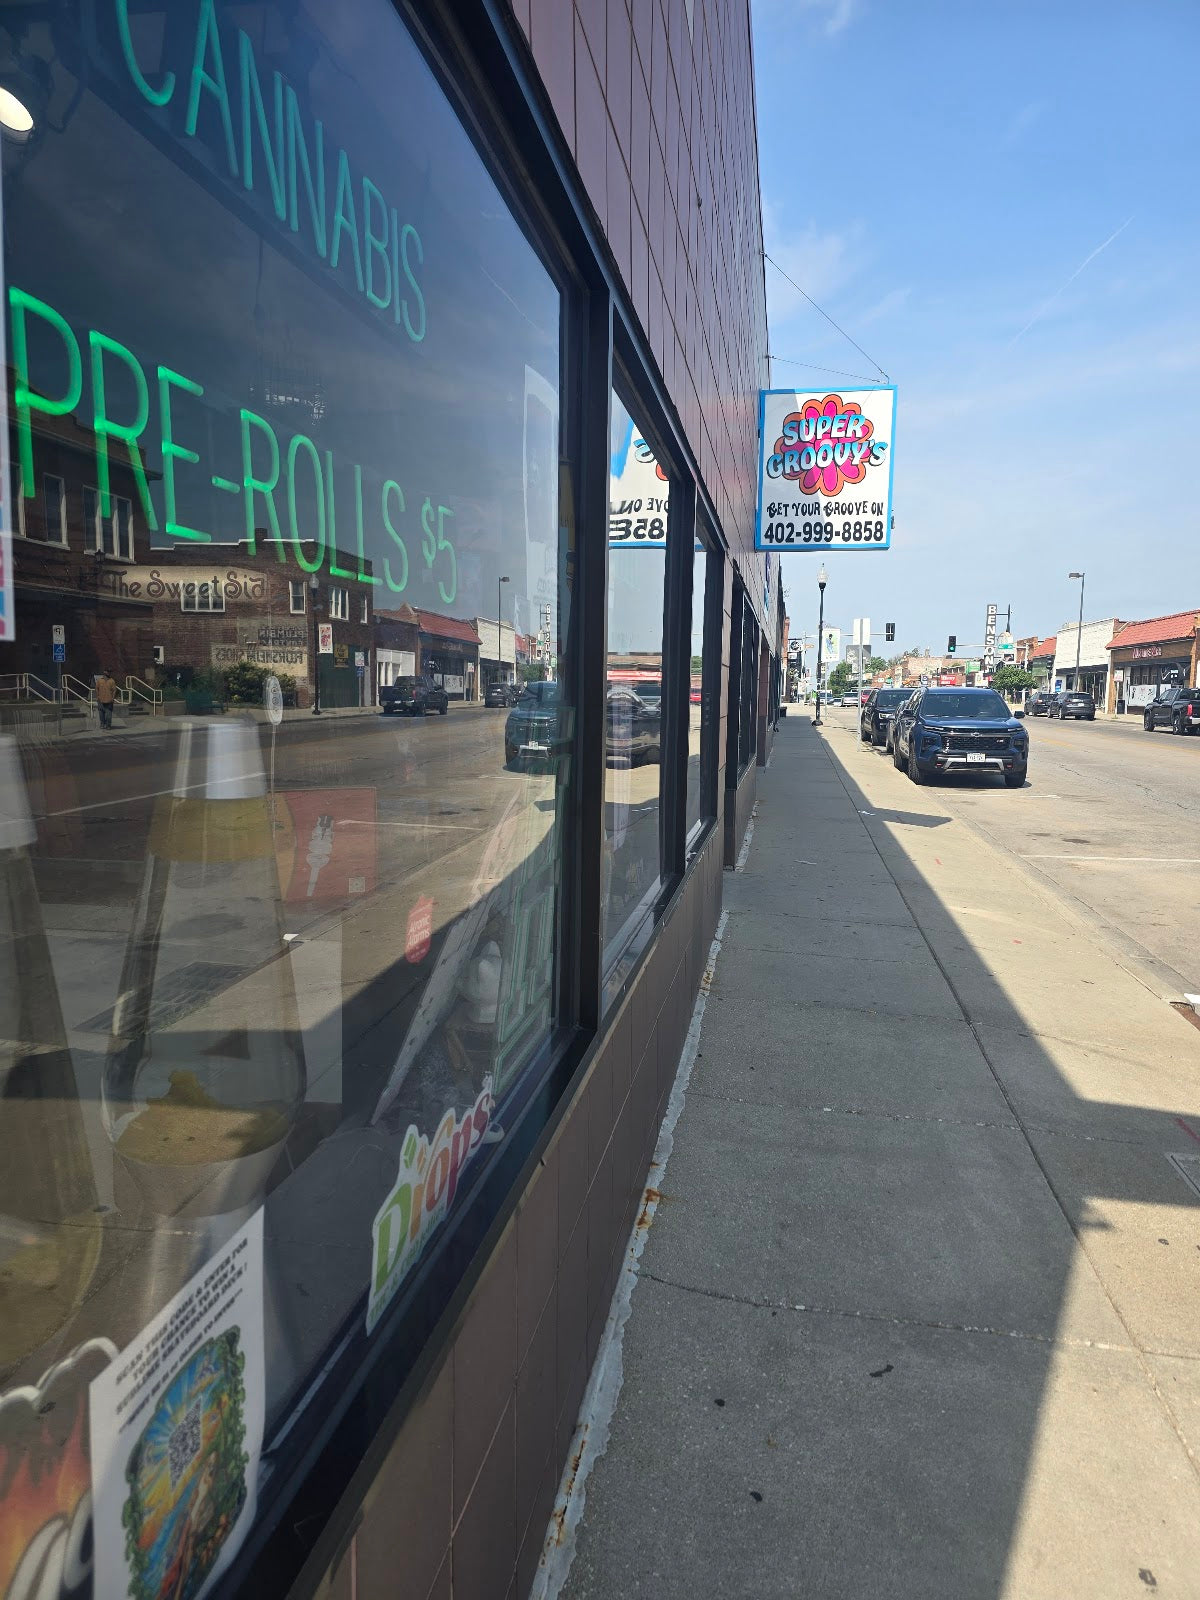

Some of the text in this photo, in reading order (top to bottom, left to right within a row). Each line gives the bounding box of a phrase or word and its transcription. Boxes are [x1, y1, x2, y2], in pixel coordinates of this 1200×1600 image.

[116, 0, 427, 343] CANNABIS
[9, 286, 458, 604] PRE-ROLLS $5
[782, 414, 867, 446] SUPER
[766, 438, 889, 479] GROOVY'S
[767, 500, 884, 519] GET YOUR GROOVE ON
[764, 520, 884, 544] 402-999-8858
[146, 569, 220, 599] Sweet
[373, 1090, 491, 1299] Drops
[170, 1293, 195, 1325] CODE
[203, 1255, 231, 1289] ENTER
[232, 1237, 248, 1260] FOR
[221, 1266, 243, 1295] DECK
[133, 1263, 236, 1381] YOUR CHANCE TO WIN A
